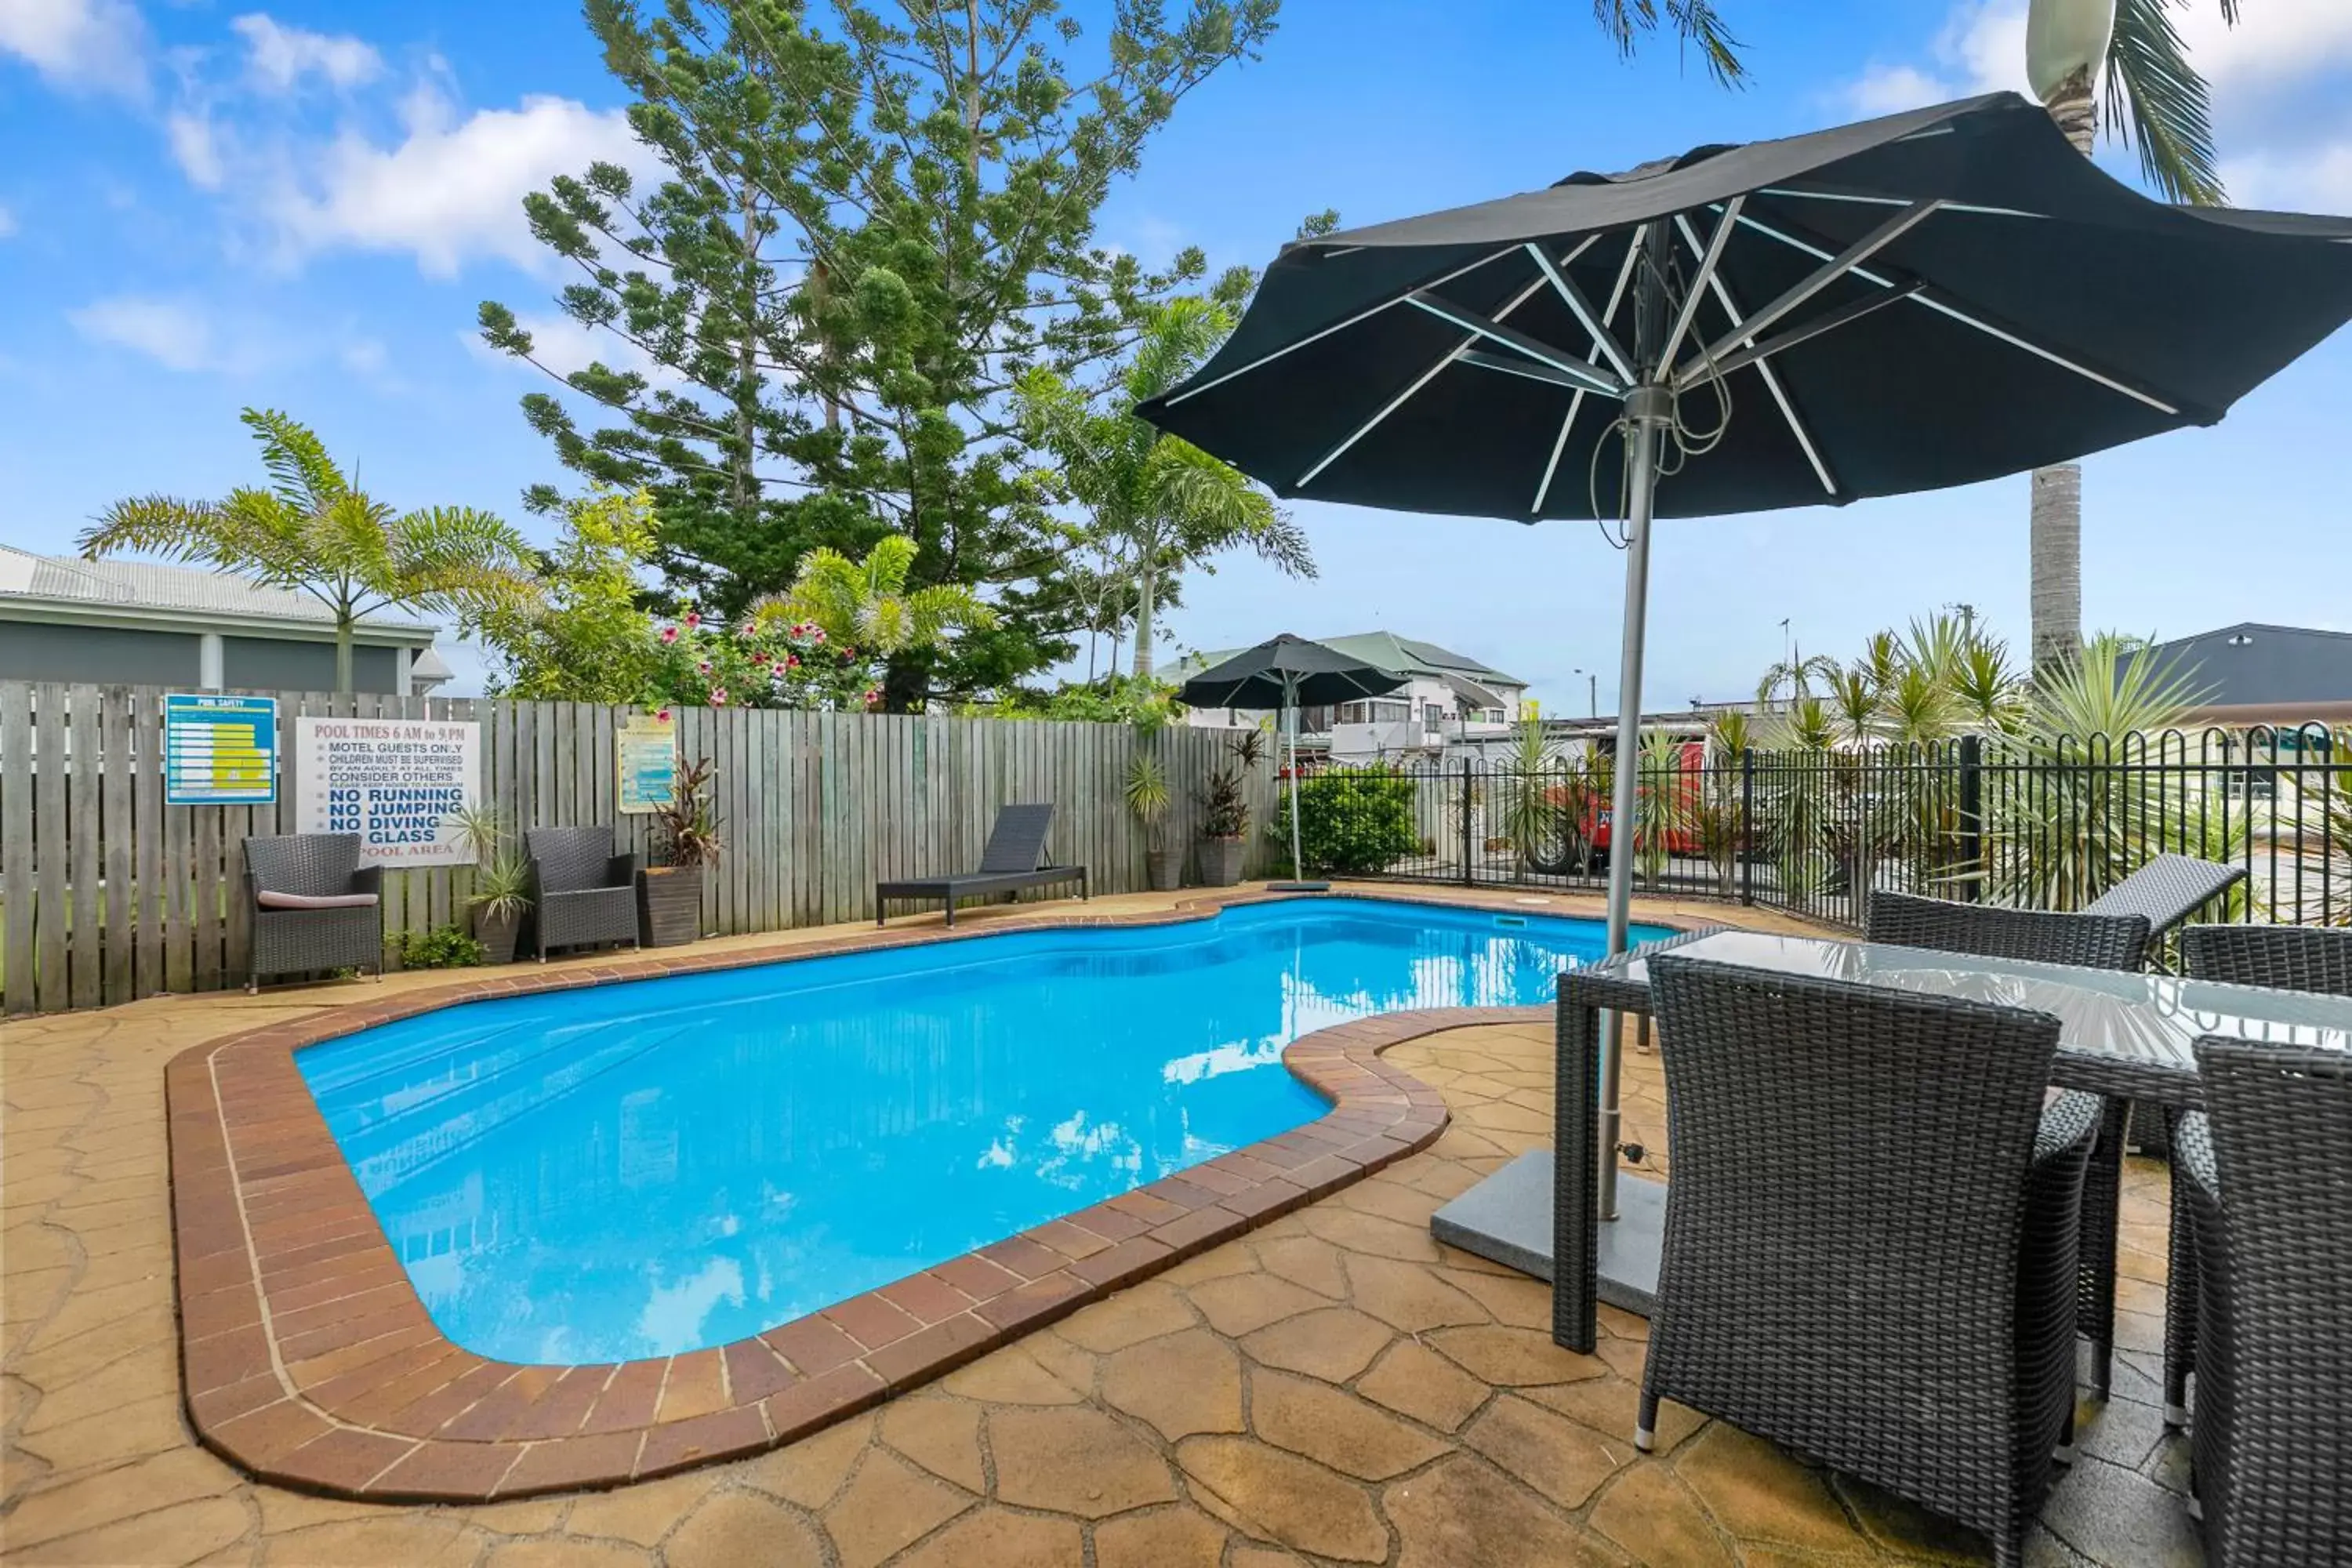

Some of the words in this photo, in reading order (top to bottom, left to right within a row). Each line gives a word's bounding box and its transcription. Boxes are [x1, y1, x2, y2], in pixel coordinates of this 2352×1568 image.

[315, 725, 350, 739] POOL
[353, 726, 390, 739] TIMES
[393, 727, 401, 739] 6
[404, 727, 421, 739] AM
[424, 728, 436, 740] to
[448, 728, 466, 740] PM
[329, 742, 374, 752] MOTEL
[377, 742, 427, 753] GUESTS
[329, 754, 374, 764] CHILDREN
[376, 755, 398, 764] MUST
[401, 755, 412, 764] BE
[413, 755, 464, 765] SUPERVISED
[329, 772, 399, 782] CONSIDER
[402, 772, 453, 782] OTHERS
[329, 789, 361, 802] NO
[368, 789, 463, 801] RUNNING
[329, 804, 361, 816] NO
[368, 802, 462, 815] JUMPING
[329, 818, 361, 831] NO
[368, 816, 440, 830] DIVING
[368, 829, 435, 844] GLASS
[408, 844, 454, 856] AREA
